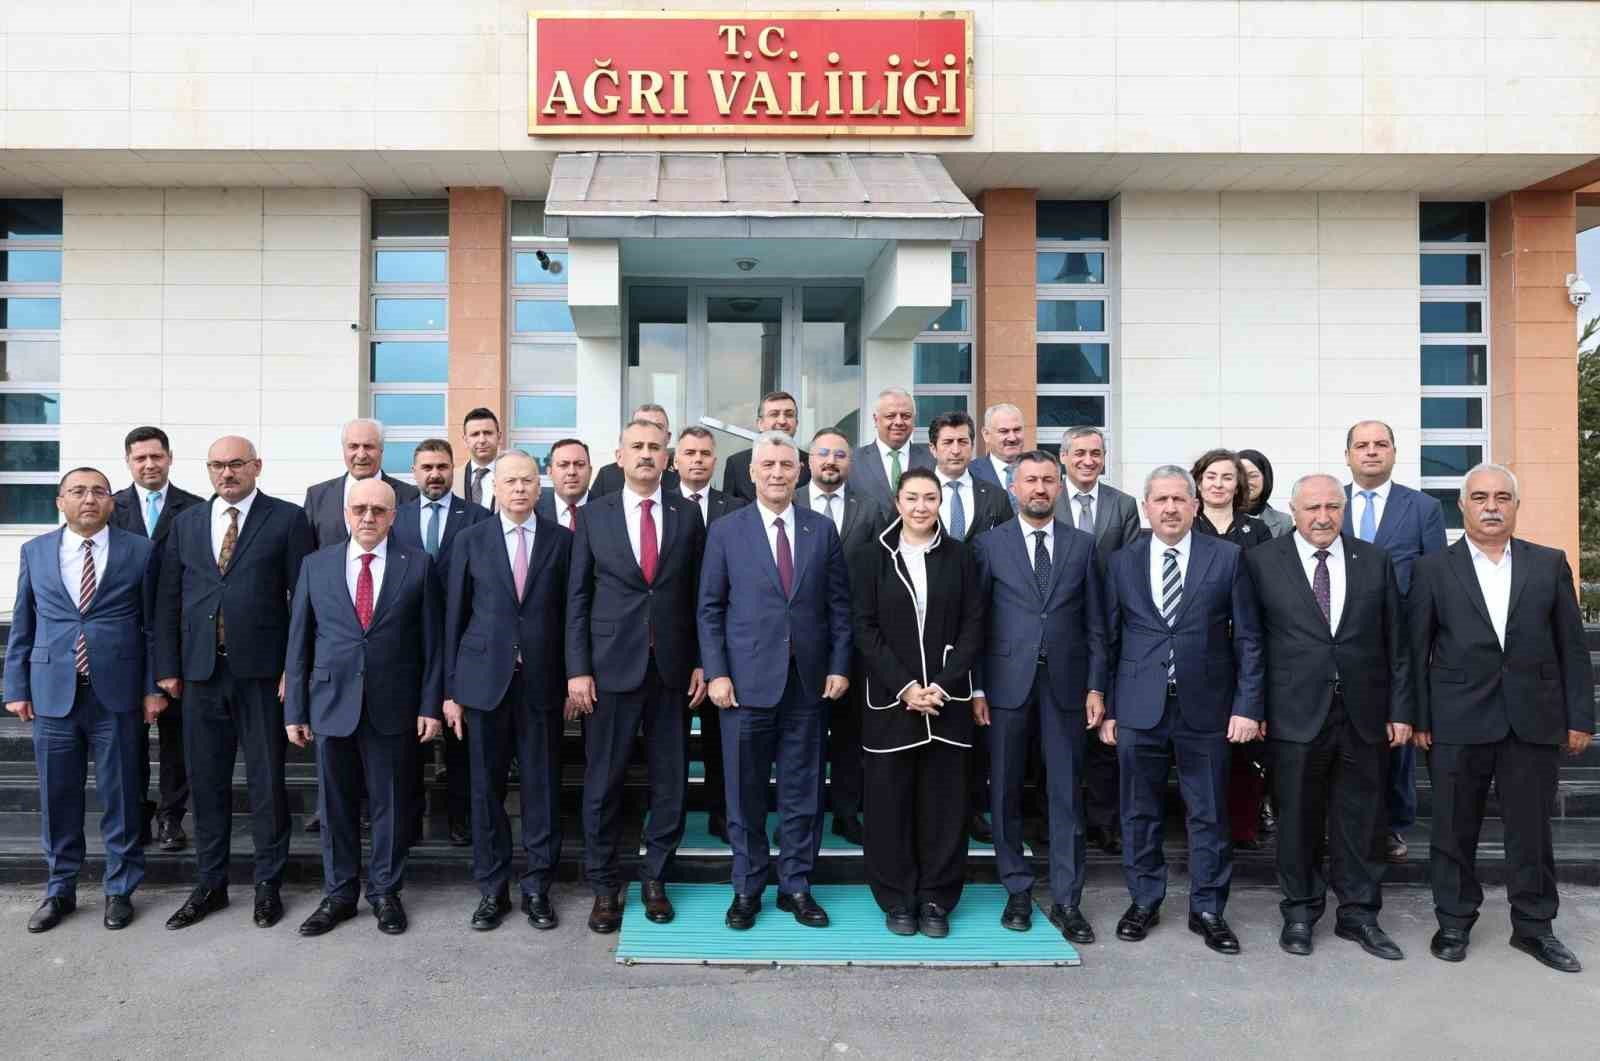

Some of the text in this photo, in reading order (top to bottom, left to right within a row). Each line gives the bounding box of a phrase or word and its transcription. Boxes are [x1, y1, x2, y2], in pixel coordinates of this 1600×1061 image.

[718, 25, 799, 60] T.C.
[542, 52, 961, 117] AĞRI VALİLİĞİ
